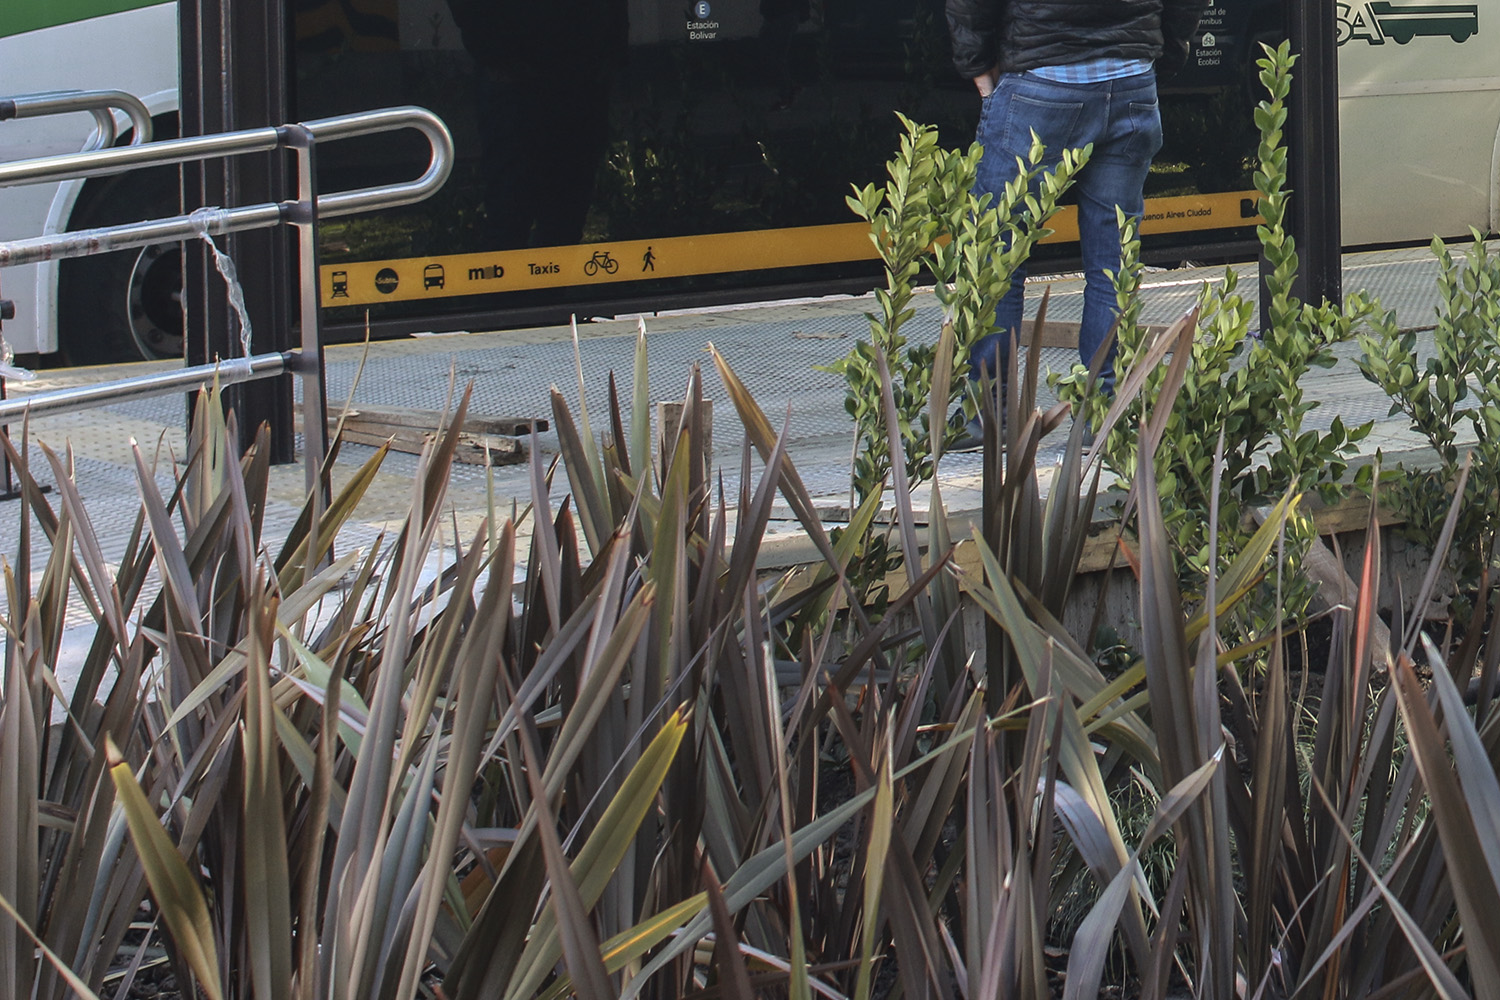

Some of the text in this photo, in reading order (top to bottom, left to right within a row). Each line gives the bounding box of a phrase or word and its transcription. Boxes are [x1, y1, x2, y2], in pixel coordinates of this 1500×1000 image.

[686, 20, 719, 29] Estación
[1141, 208, 1212, 221] uenos Aires Ciudad
[528, 262, 560, 275] Taxis
